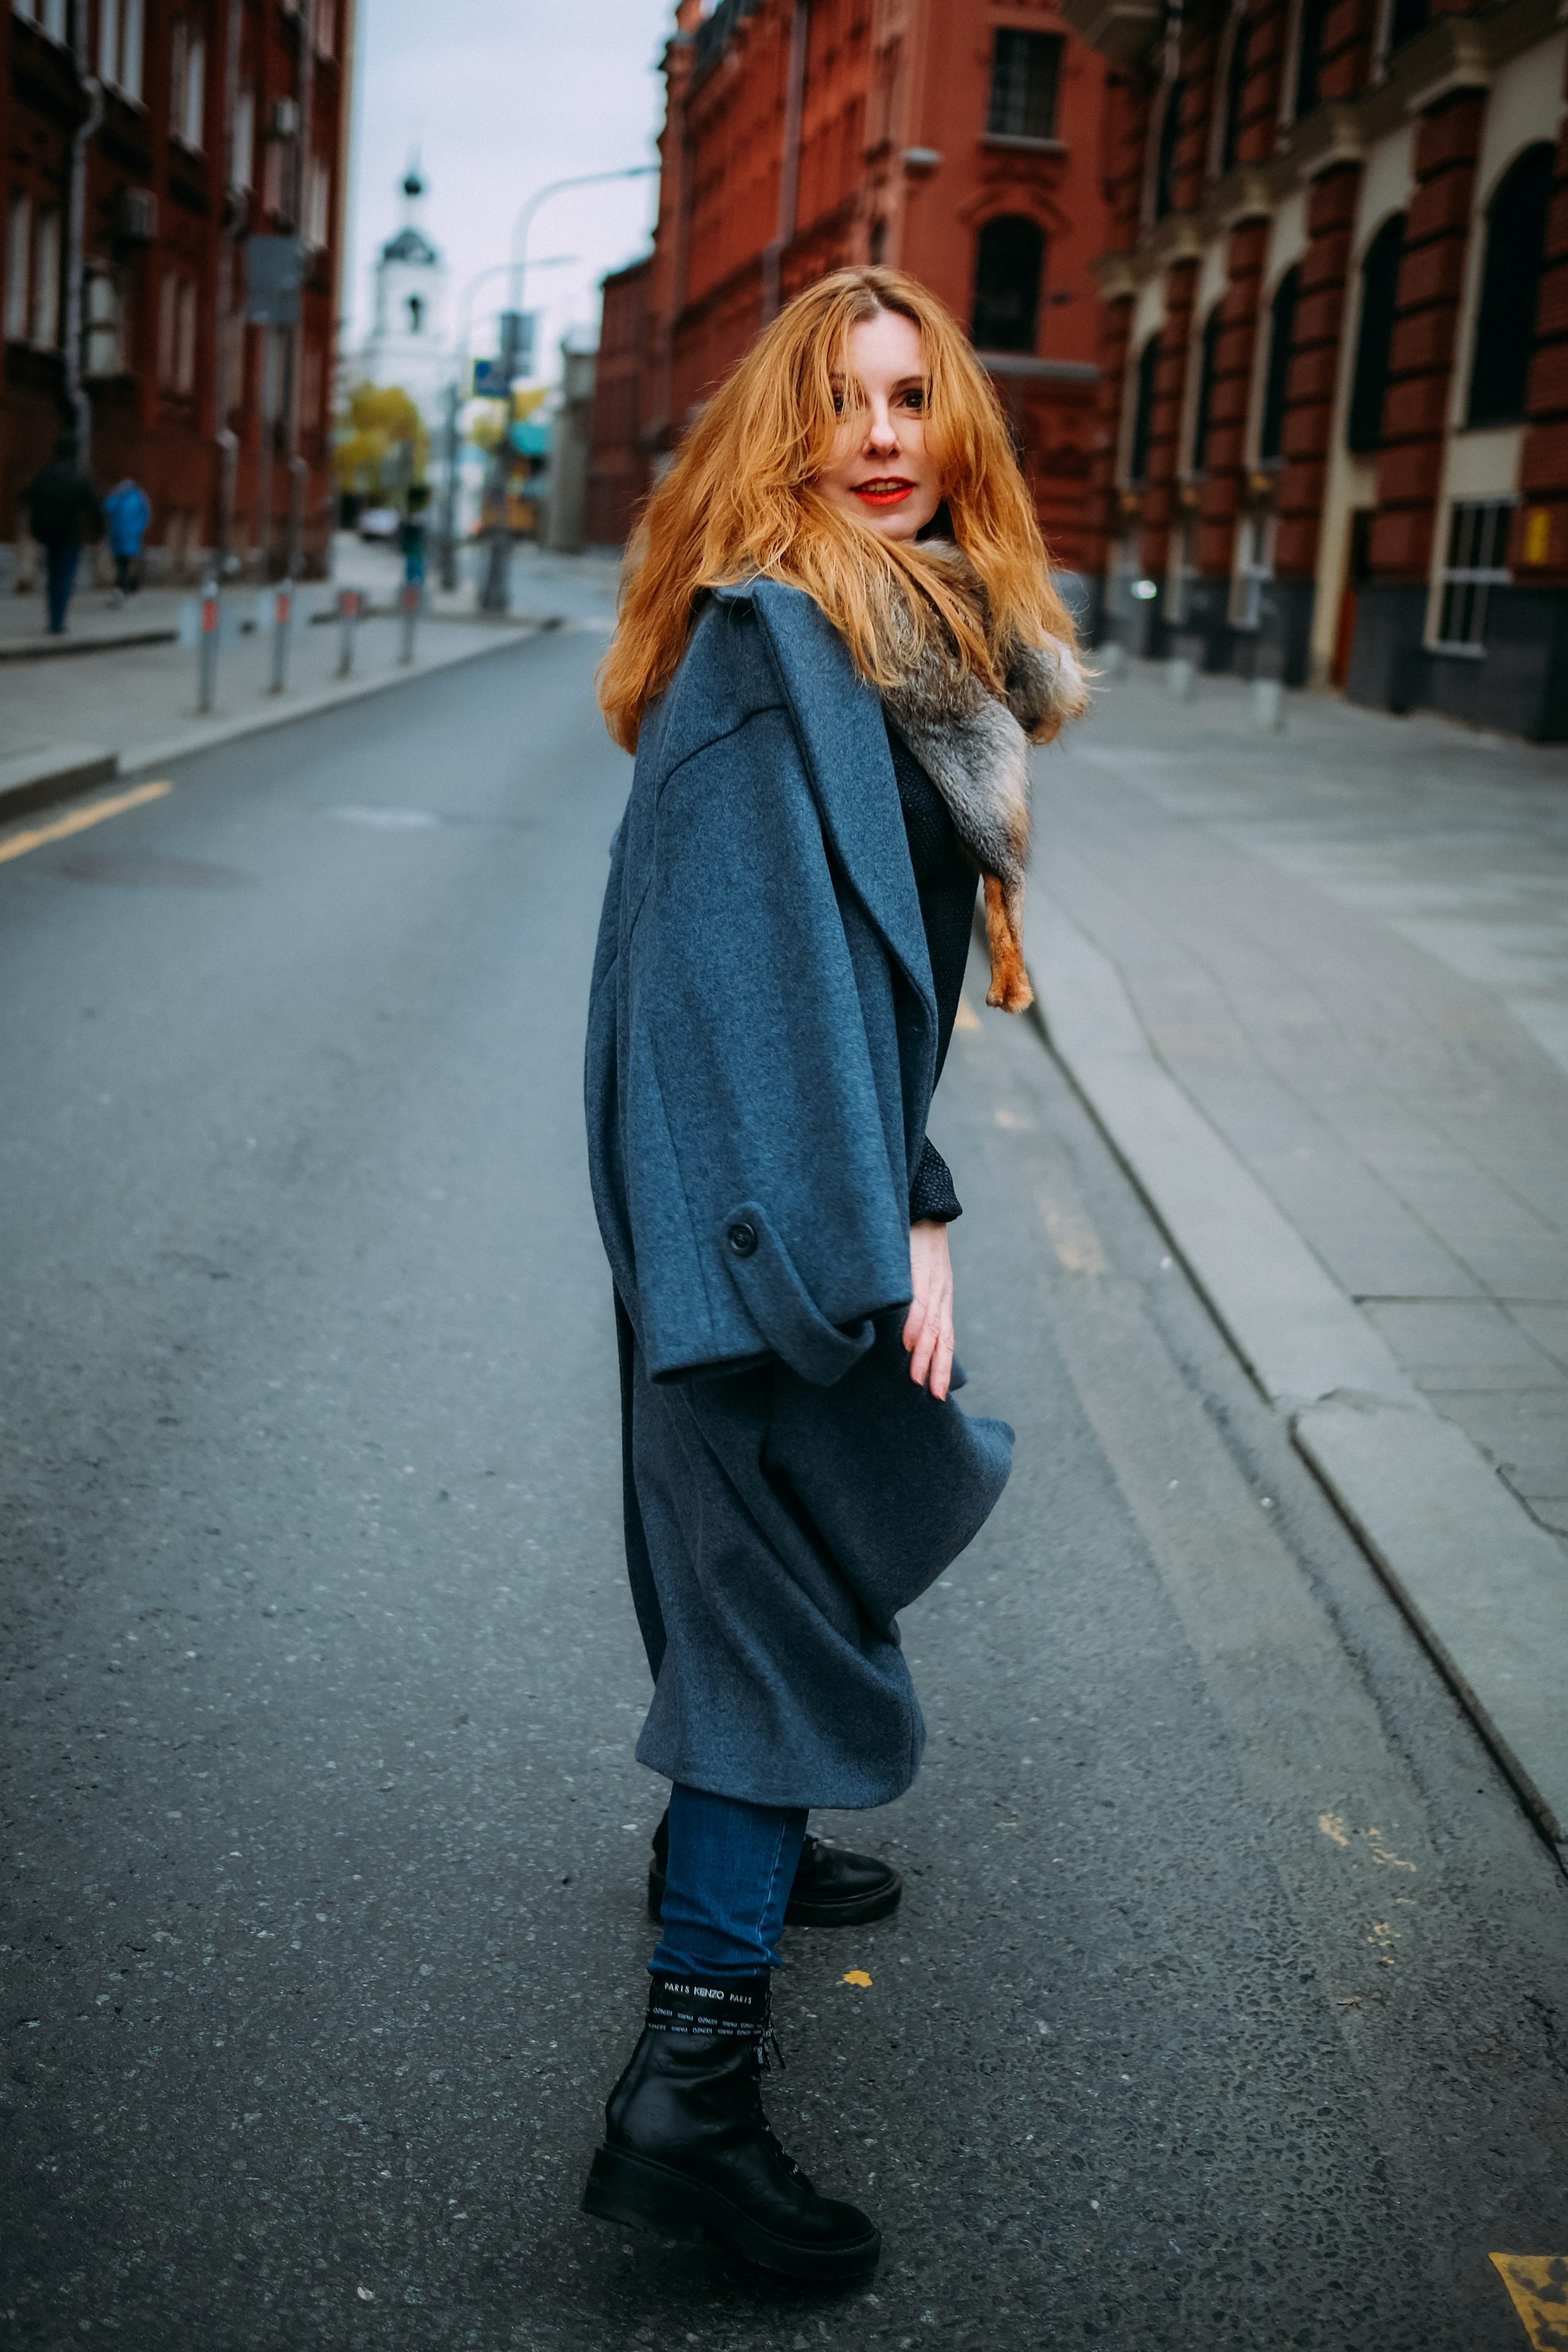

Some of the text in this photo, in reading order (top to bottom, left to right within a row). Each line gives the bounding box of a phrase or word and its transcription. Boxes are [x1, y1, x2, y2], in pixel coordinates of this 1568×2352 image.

[665, 1982, 752, 2005] PARIS KENZO PARIS
[653, 2007, 673, 2017] KENZO
[698, 2016, 717, 2026] KENZO
